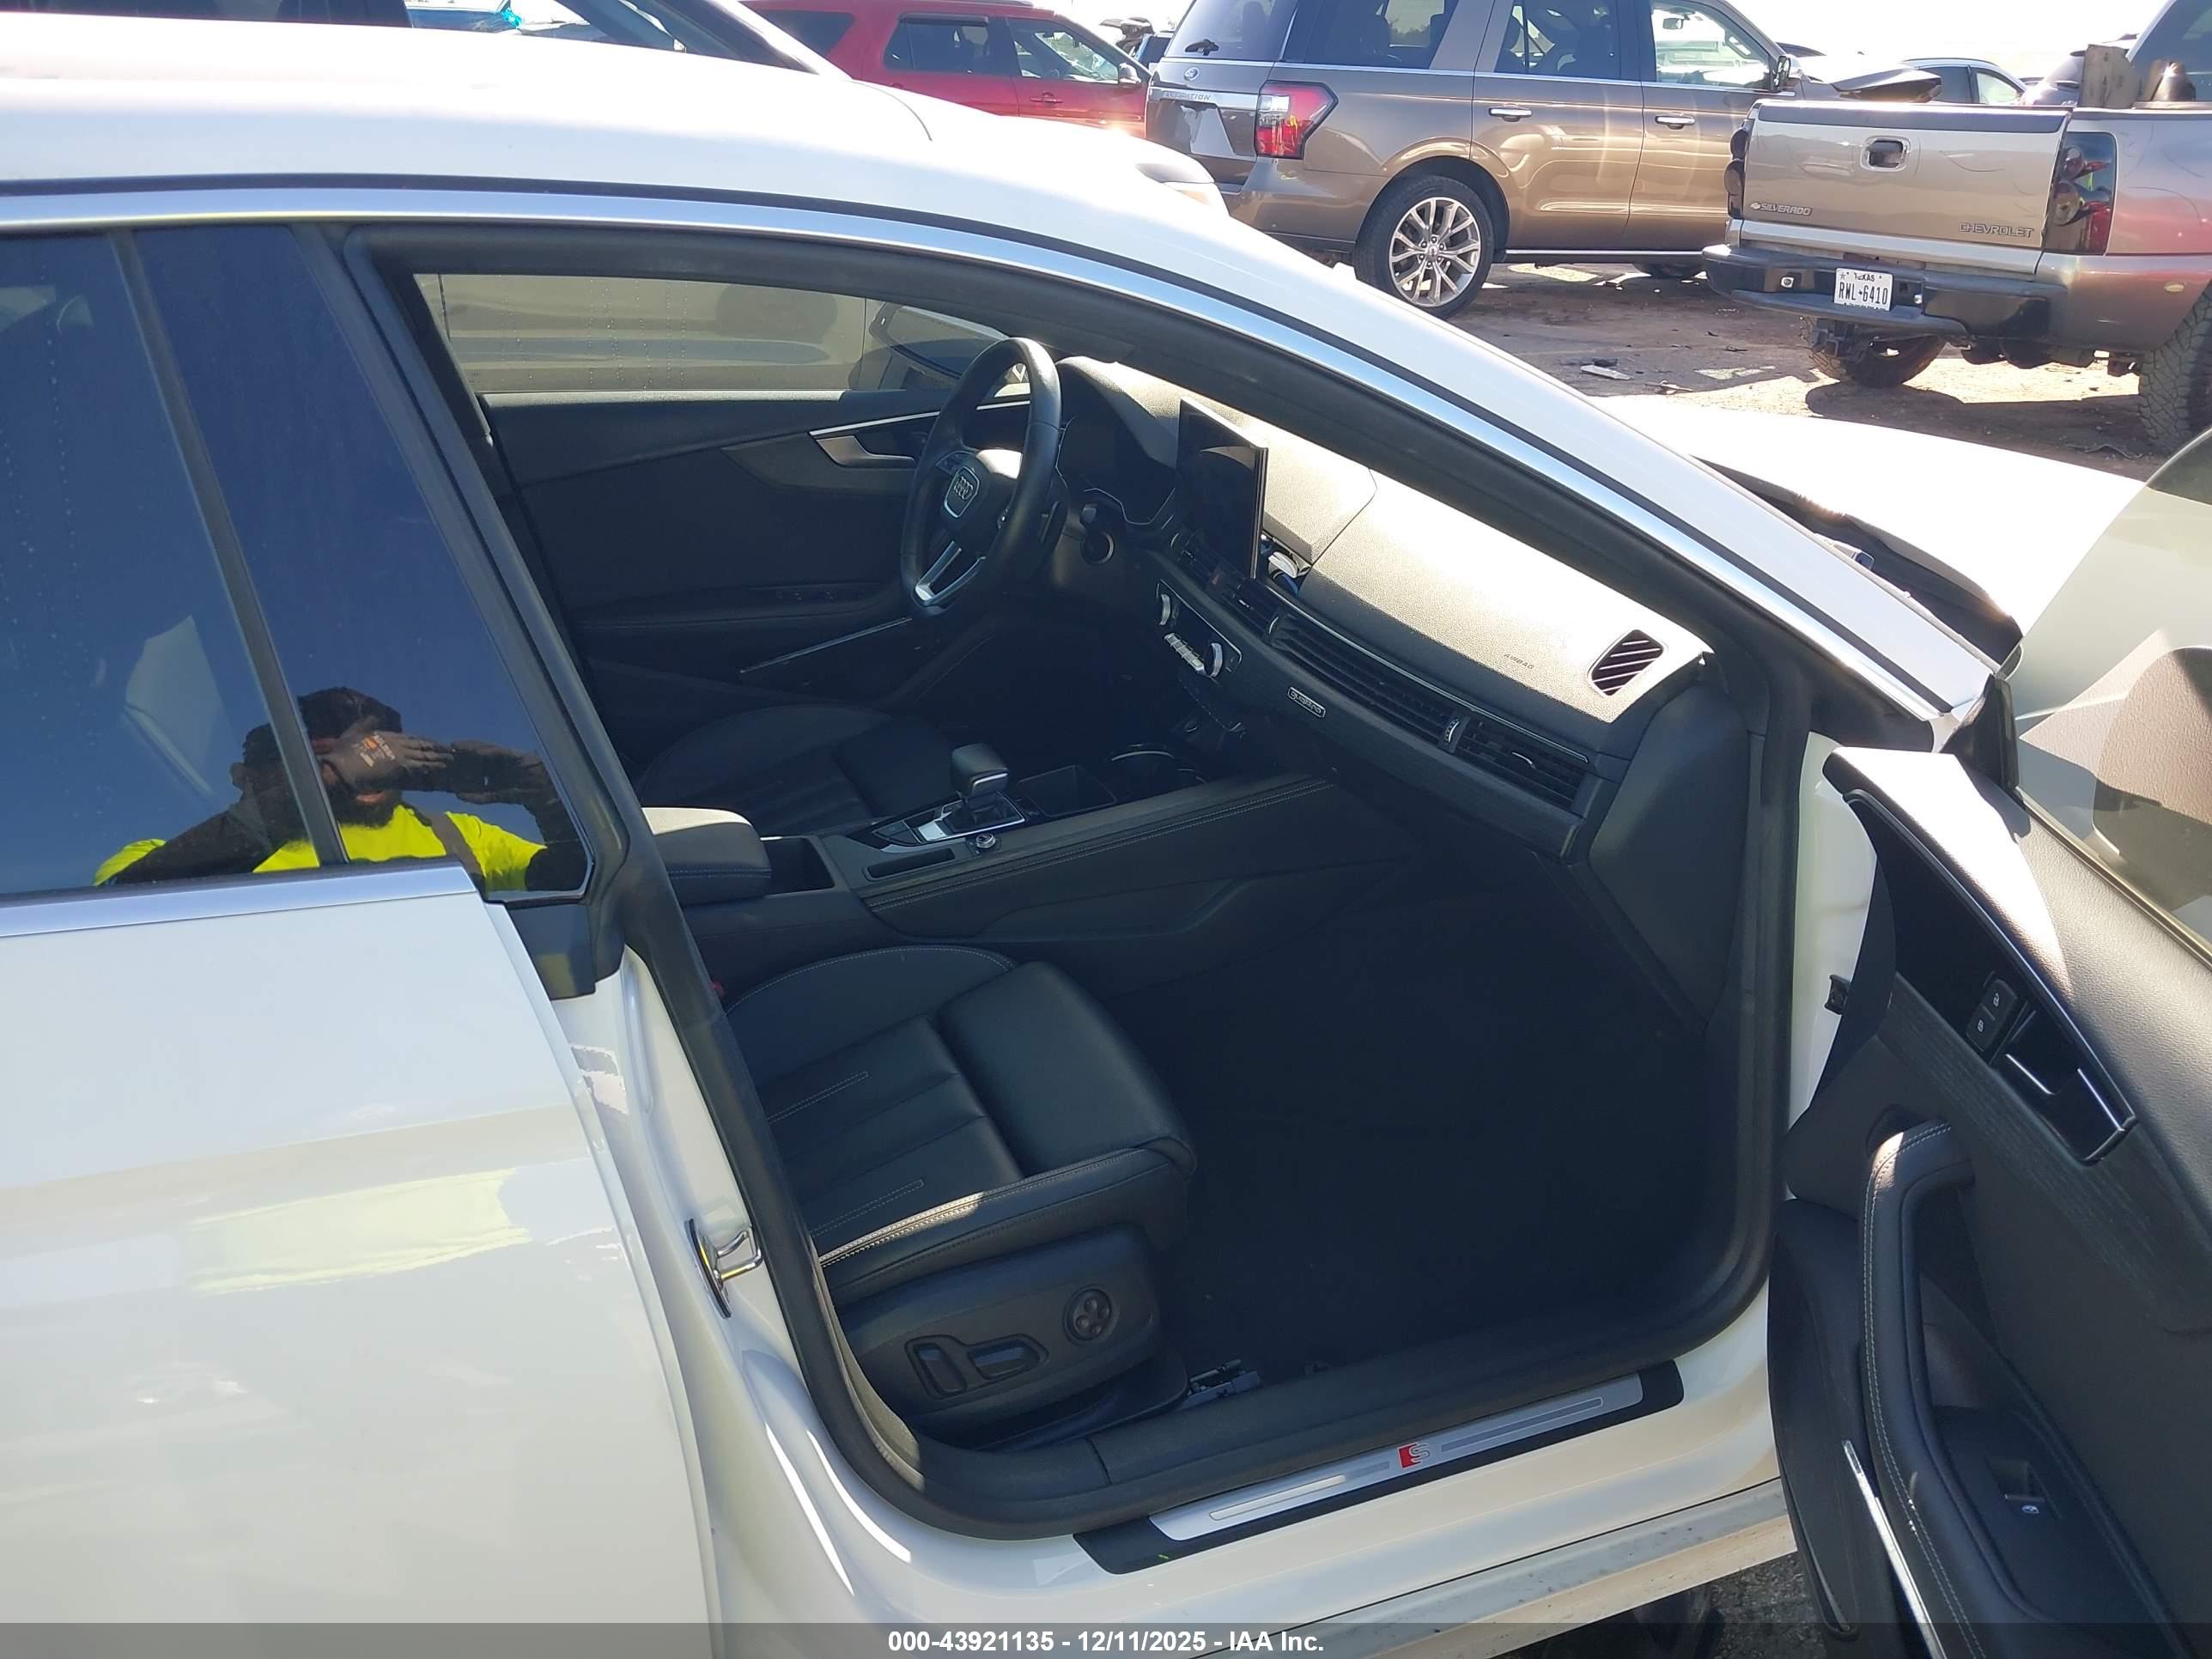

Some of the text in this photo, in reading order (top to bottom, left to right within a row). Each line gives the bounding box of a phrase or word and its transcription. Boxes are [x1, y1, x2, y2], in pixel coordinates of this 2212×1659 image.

[1759, 203, 1812, 216] SILVERADO
[1959, 222, 2034, 239] CHEVROLET
[1853, 272, 1875, 282] TEXAS
[1504, 653, 1534, 670] AIRBAG
